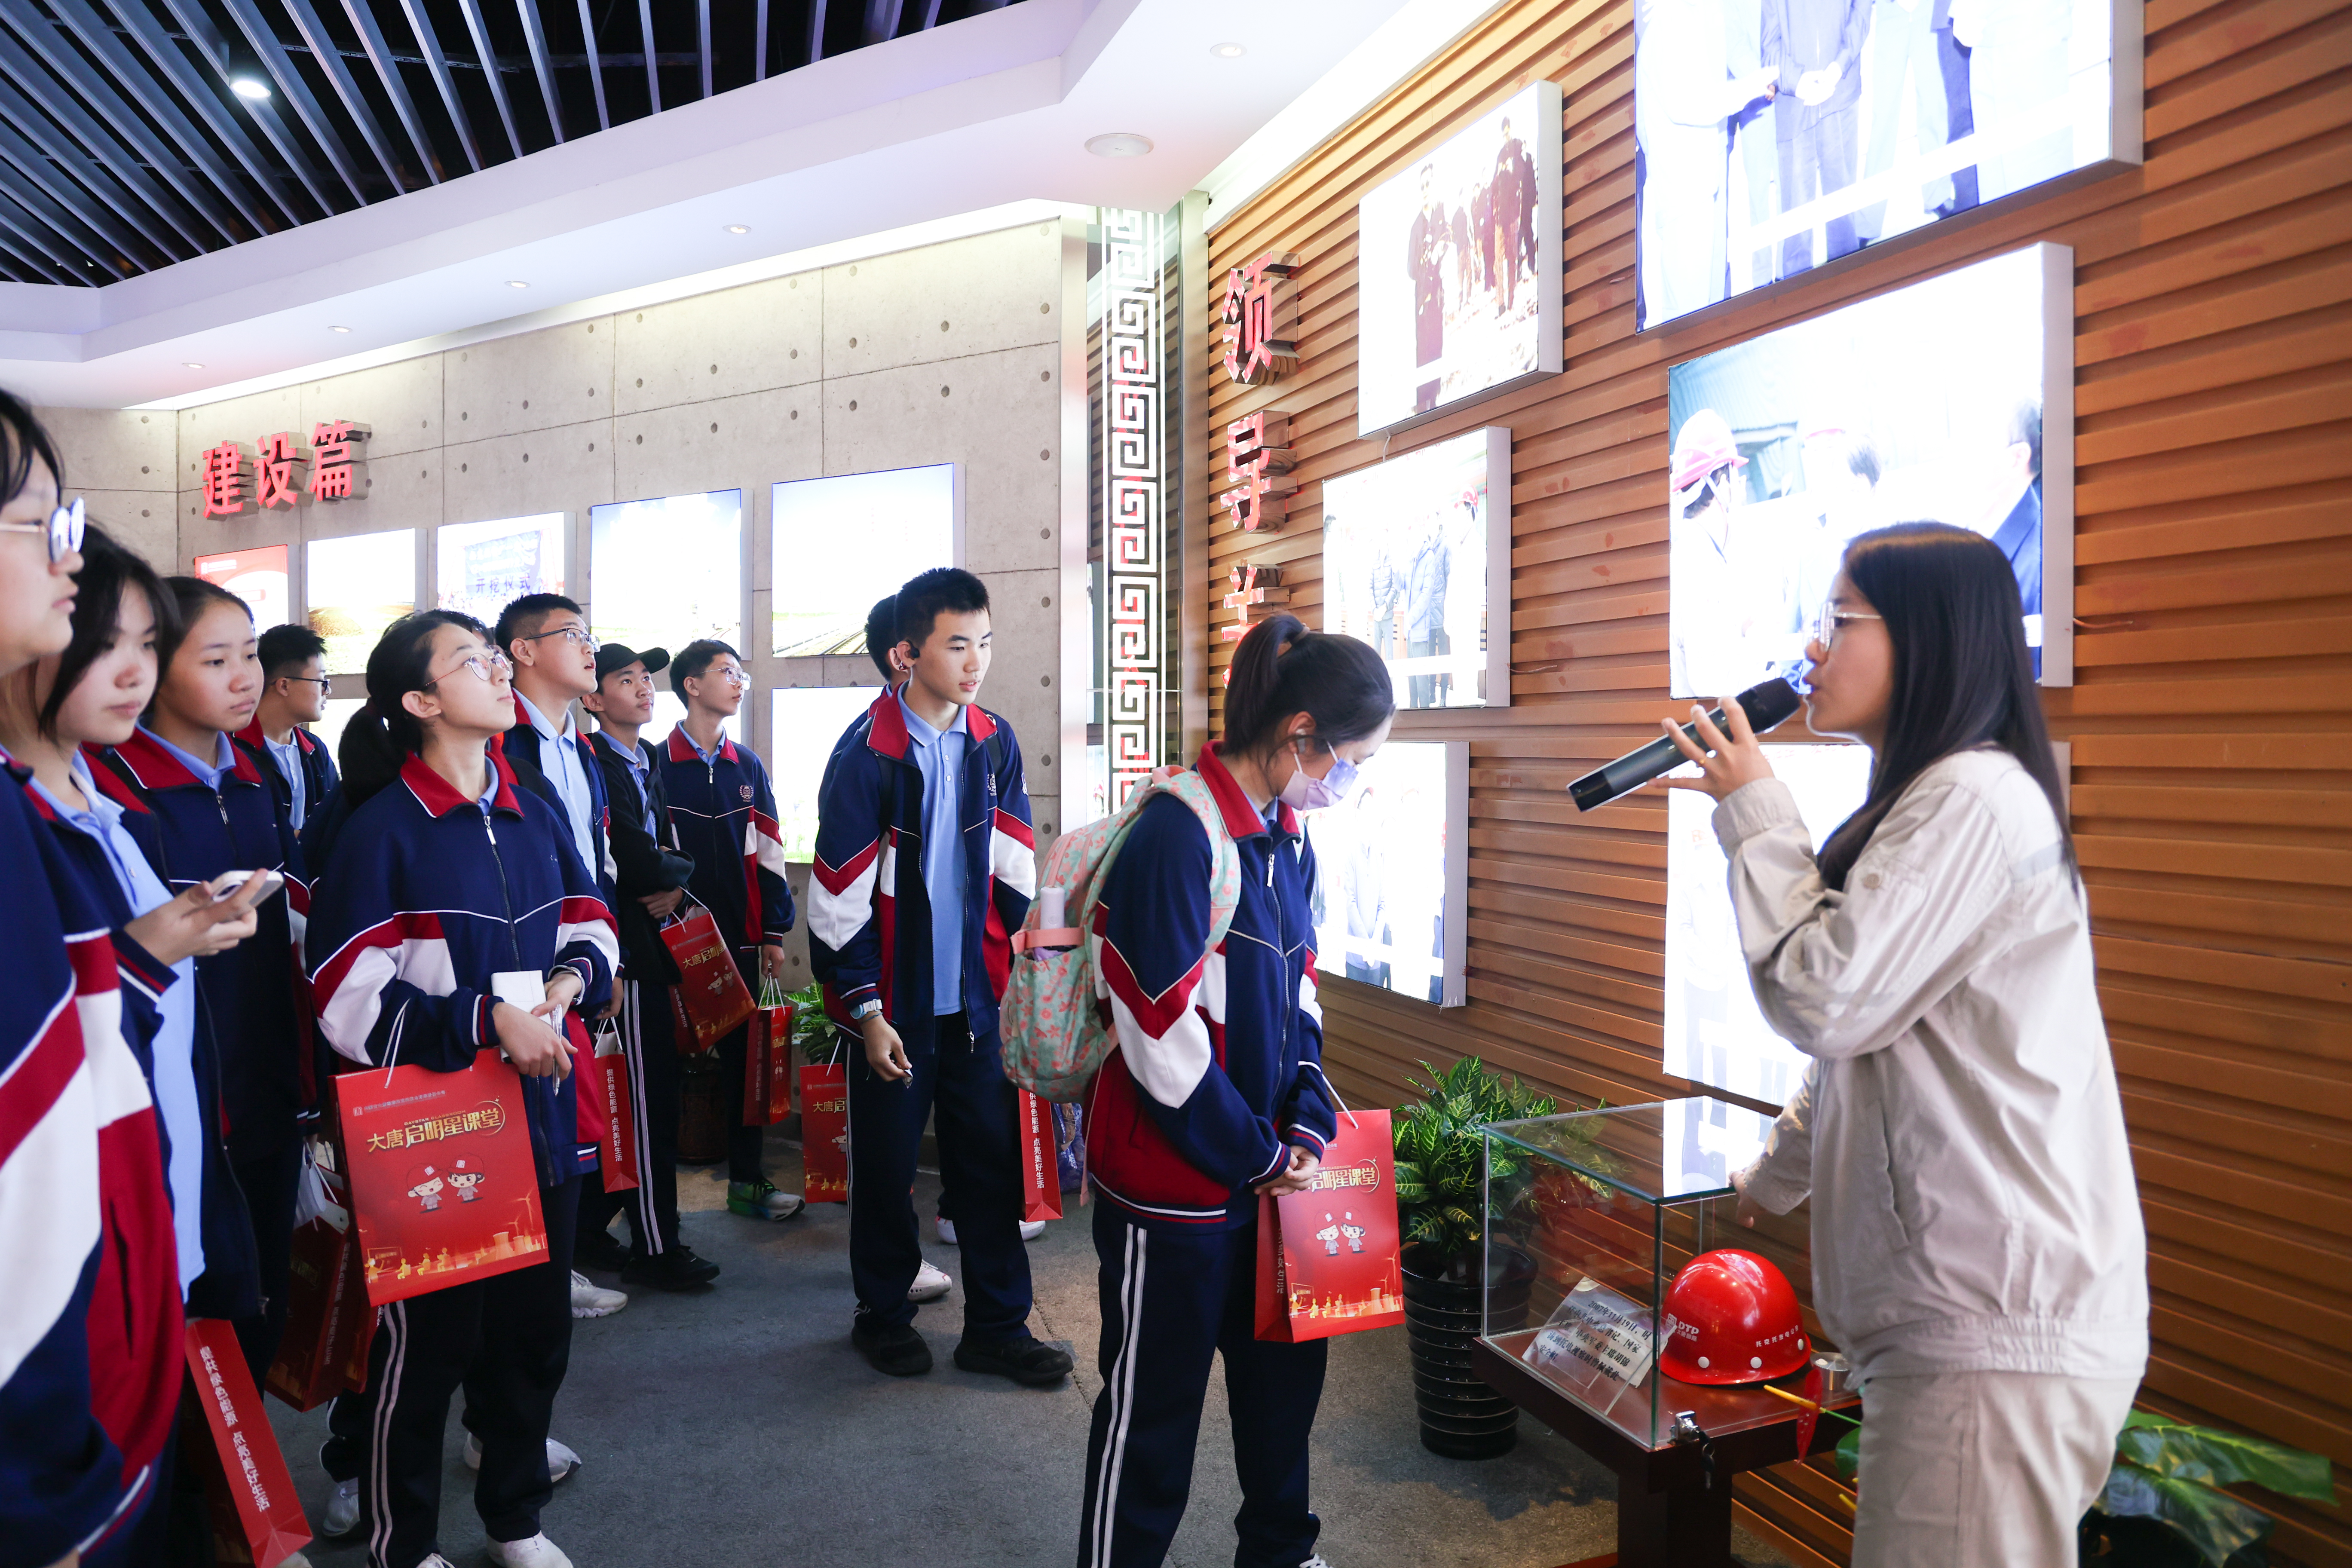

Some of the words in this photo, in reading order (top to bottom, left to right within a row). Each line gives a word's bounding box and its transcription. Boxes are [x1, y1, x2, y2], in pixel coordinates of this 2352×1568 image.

[202, 419, 355, 518] 建设篇
[404, 1118, 429, 1126] DAYSTAR
[606, 1069, 618, 1114] 提供绿色能源
[612, 1117, 623, 1162] 点亮美好生活
[813, 1100, 846, 1113] 大唐启
[367, 1108, 501, 1153] 大唐启明星课堂
[1033, 1137, 1045, 1189] 点亮美好生活
[1307, 1167, 1376, 1192] 启明星课堂
[1678, 1321, 1700, 1335] DTP
